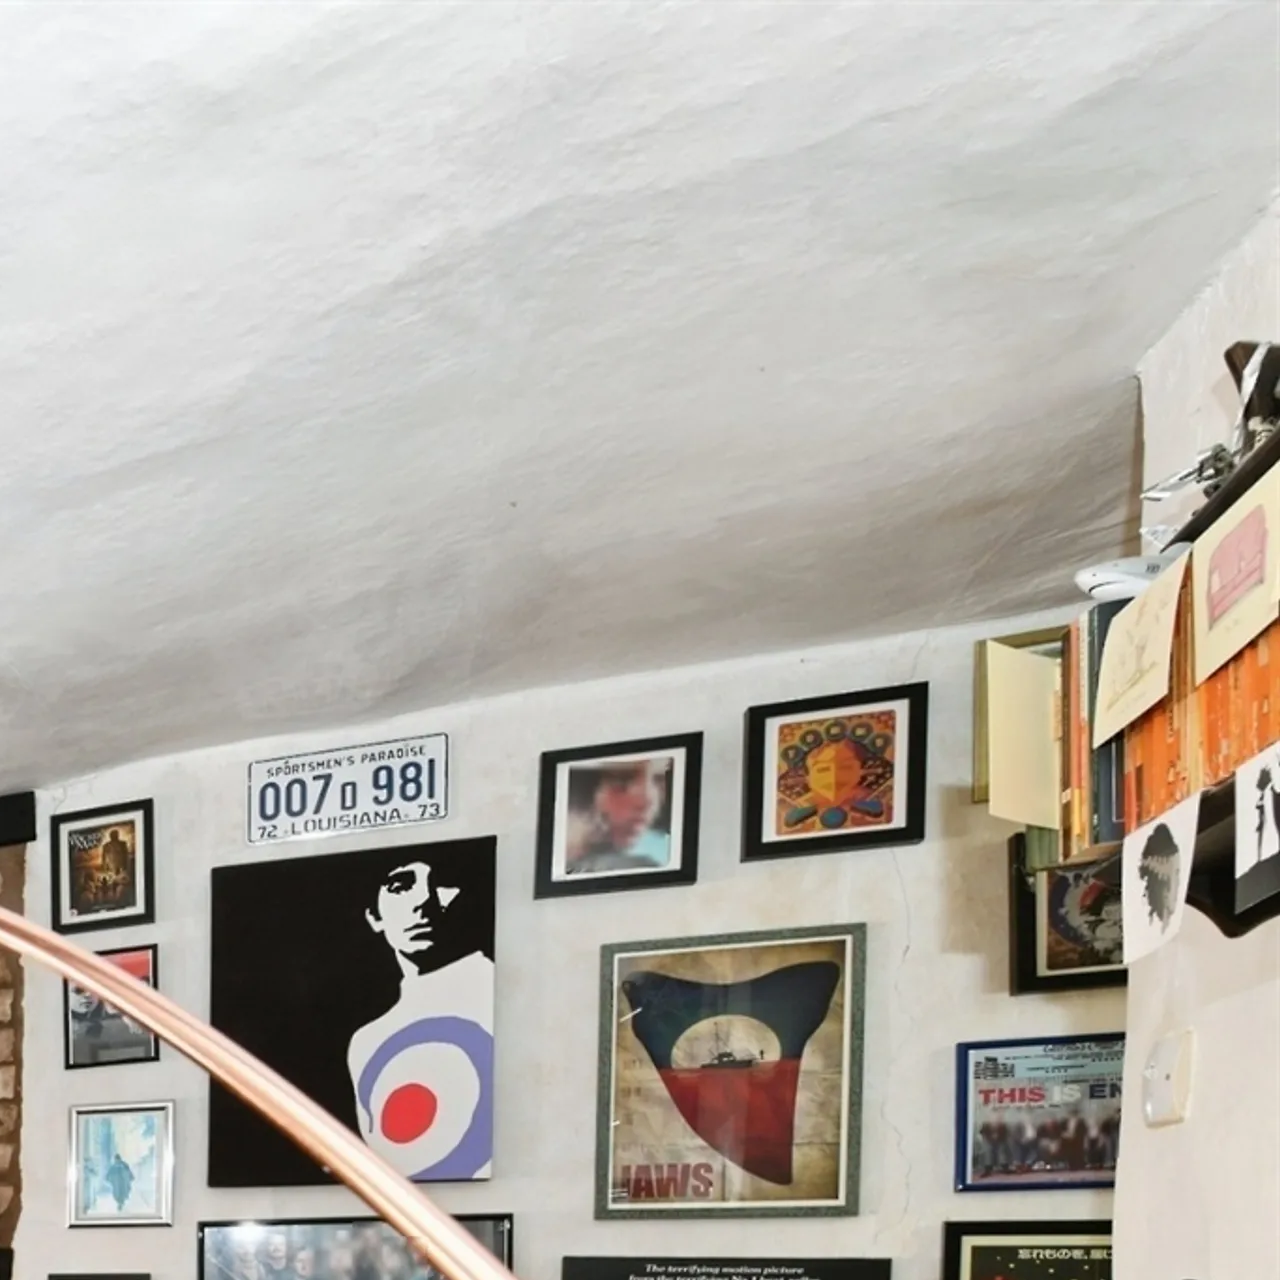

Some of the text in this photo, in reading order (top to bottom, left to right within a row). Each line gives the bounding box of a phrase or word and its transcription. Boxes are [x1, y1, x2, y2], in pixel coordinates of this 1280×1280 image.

[266, 744, 427, 778] SPORTSMEN'S PARADISE
[258, 772, 333, 821] 007
[372, 757, 436, 806] 981
[257, 802, 440, 839] 72 LOUISIANA 73
[978, 1085, 1046, 1106] THIS
[1053, 1083, 1082, 1105] IS
[619, 1161, 715, 1199] JAWS
[645, 1263, 804, 1276] The terrifying motion picture
